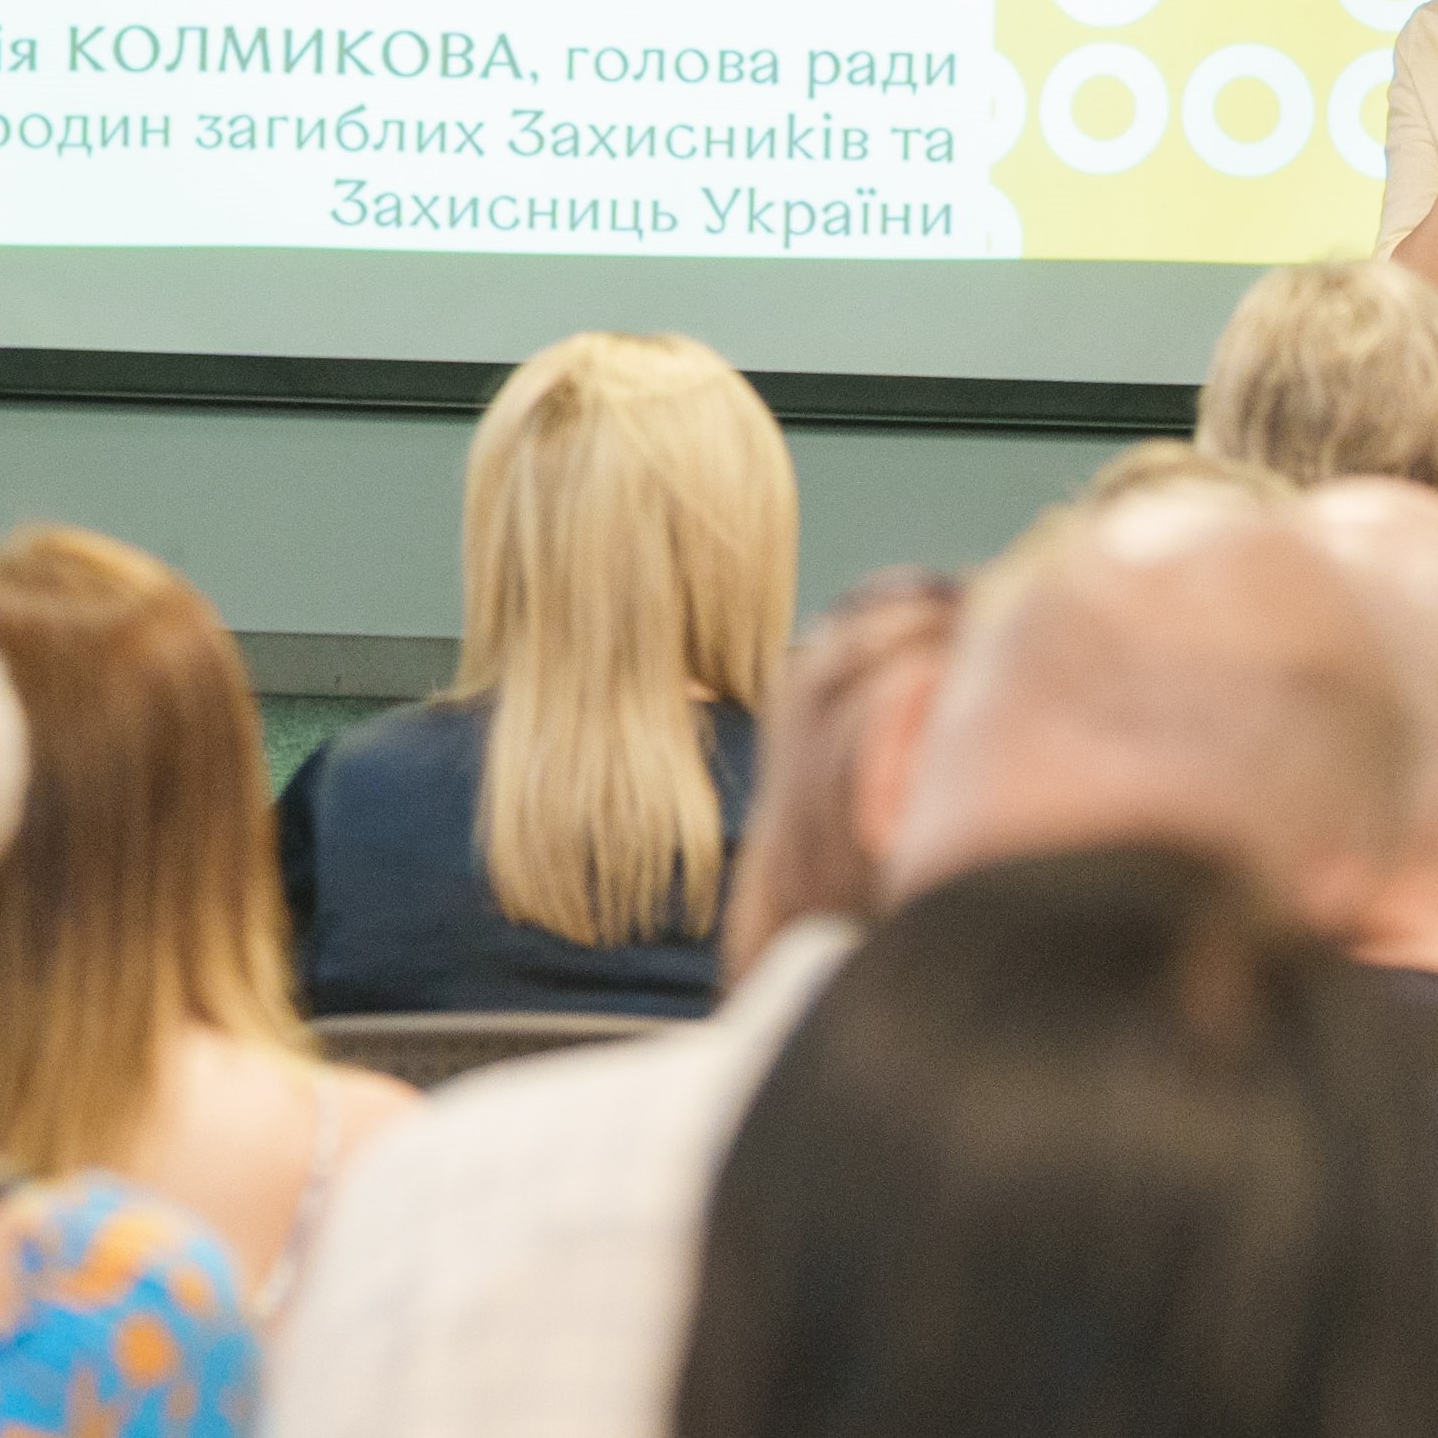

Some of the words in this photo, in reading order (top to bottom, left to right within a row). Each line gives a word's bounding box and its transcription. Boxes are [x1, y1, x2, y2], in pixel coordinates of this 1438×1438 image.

[67, 23, 540, 85] КОЛМИКОВА,
[565, 45, 781, 87] голова
[806, 48, 958, 101] ради
[193, 102, 486, 159] загиблих
[506, 107, 871, 162] Захисників
[889, 125, 956, 165] та
[328, 177, 680, 243] Захисниць
[699, 185, 954, 251] України
